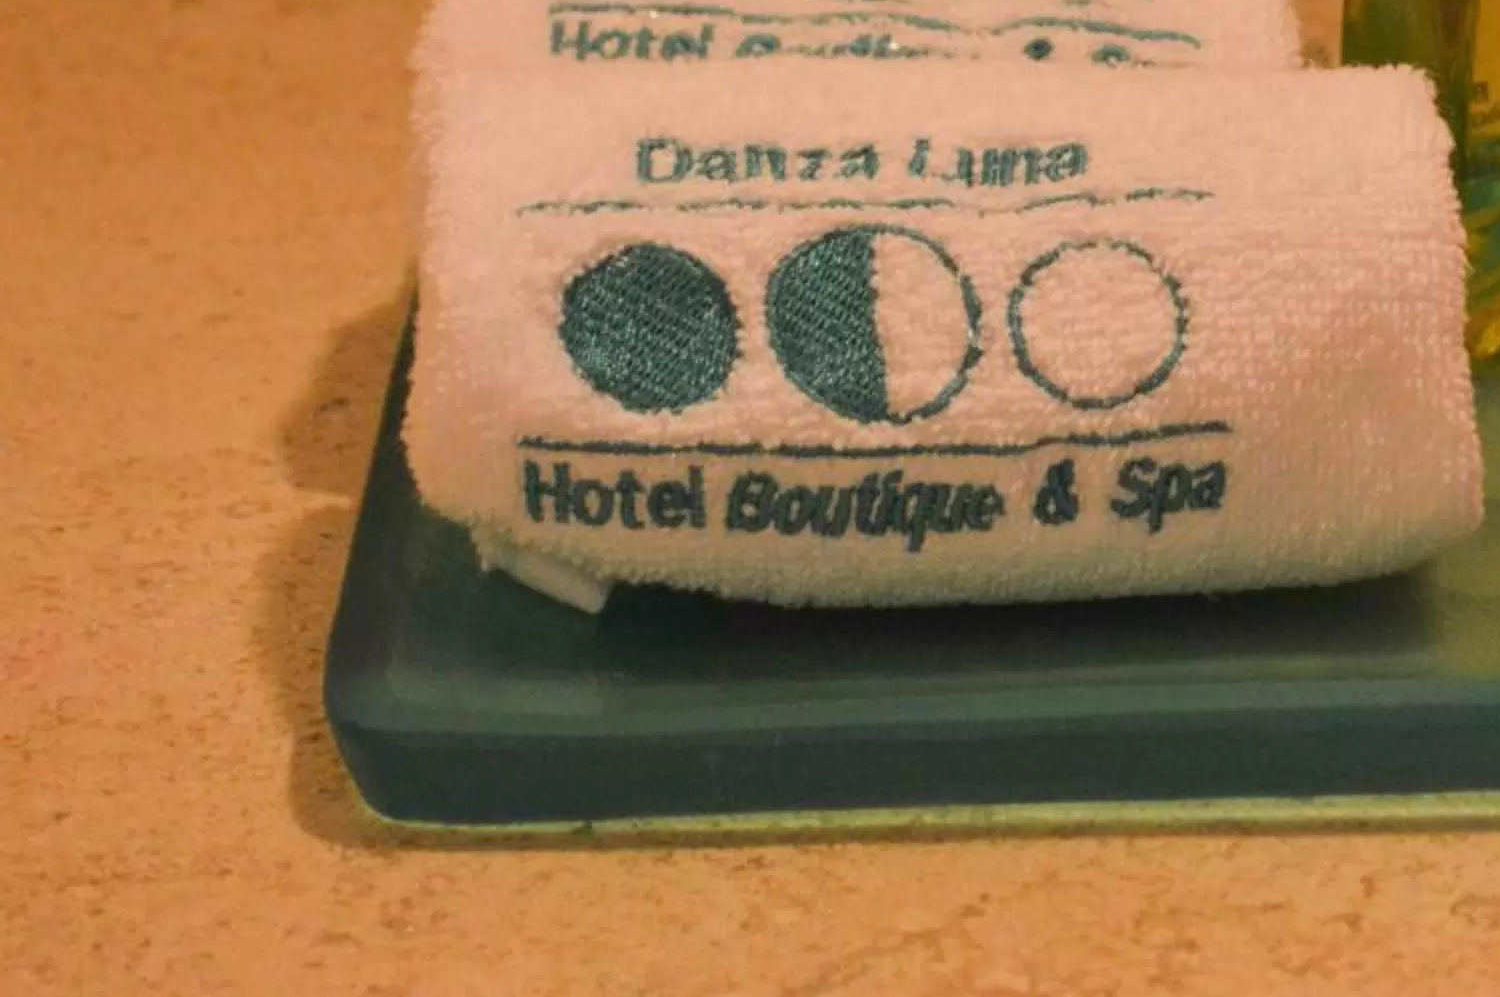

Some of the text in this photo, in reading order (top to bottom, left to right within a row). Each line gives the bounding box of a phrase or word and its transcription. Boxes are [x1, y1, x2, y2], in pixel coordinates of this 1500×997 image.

[549, 16, 714, 62] Hotel
[635, 137, 1089, 188] Danza Luna
[522, 455, 1229, 552] Hotel Boutique & Spa
